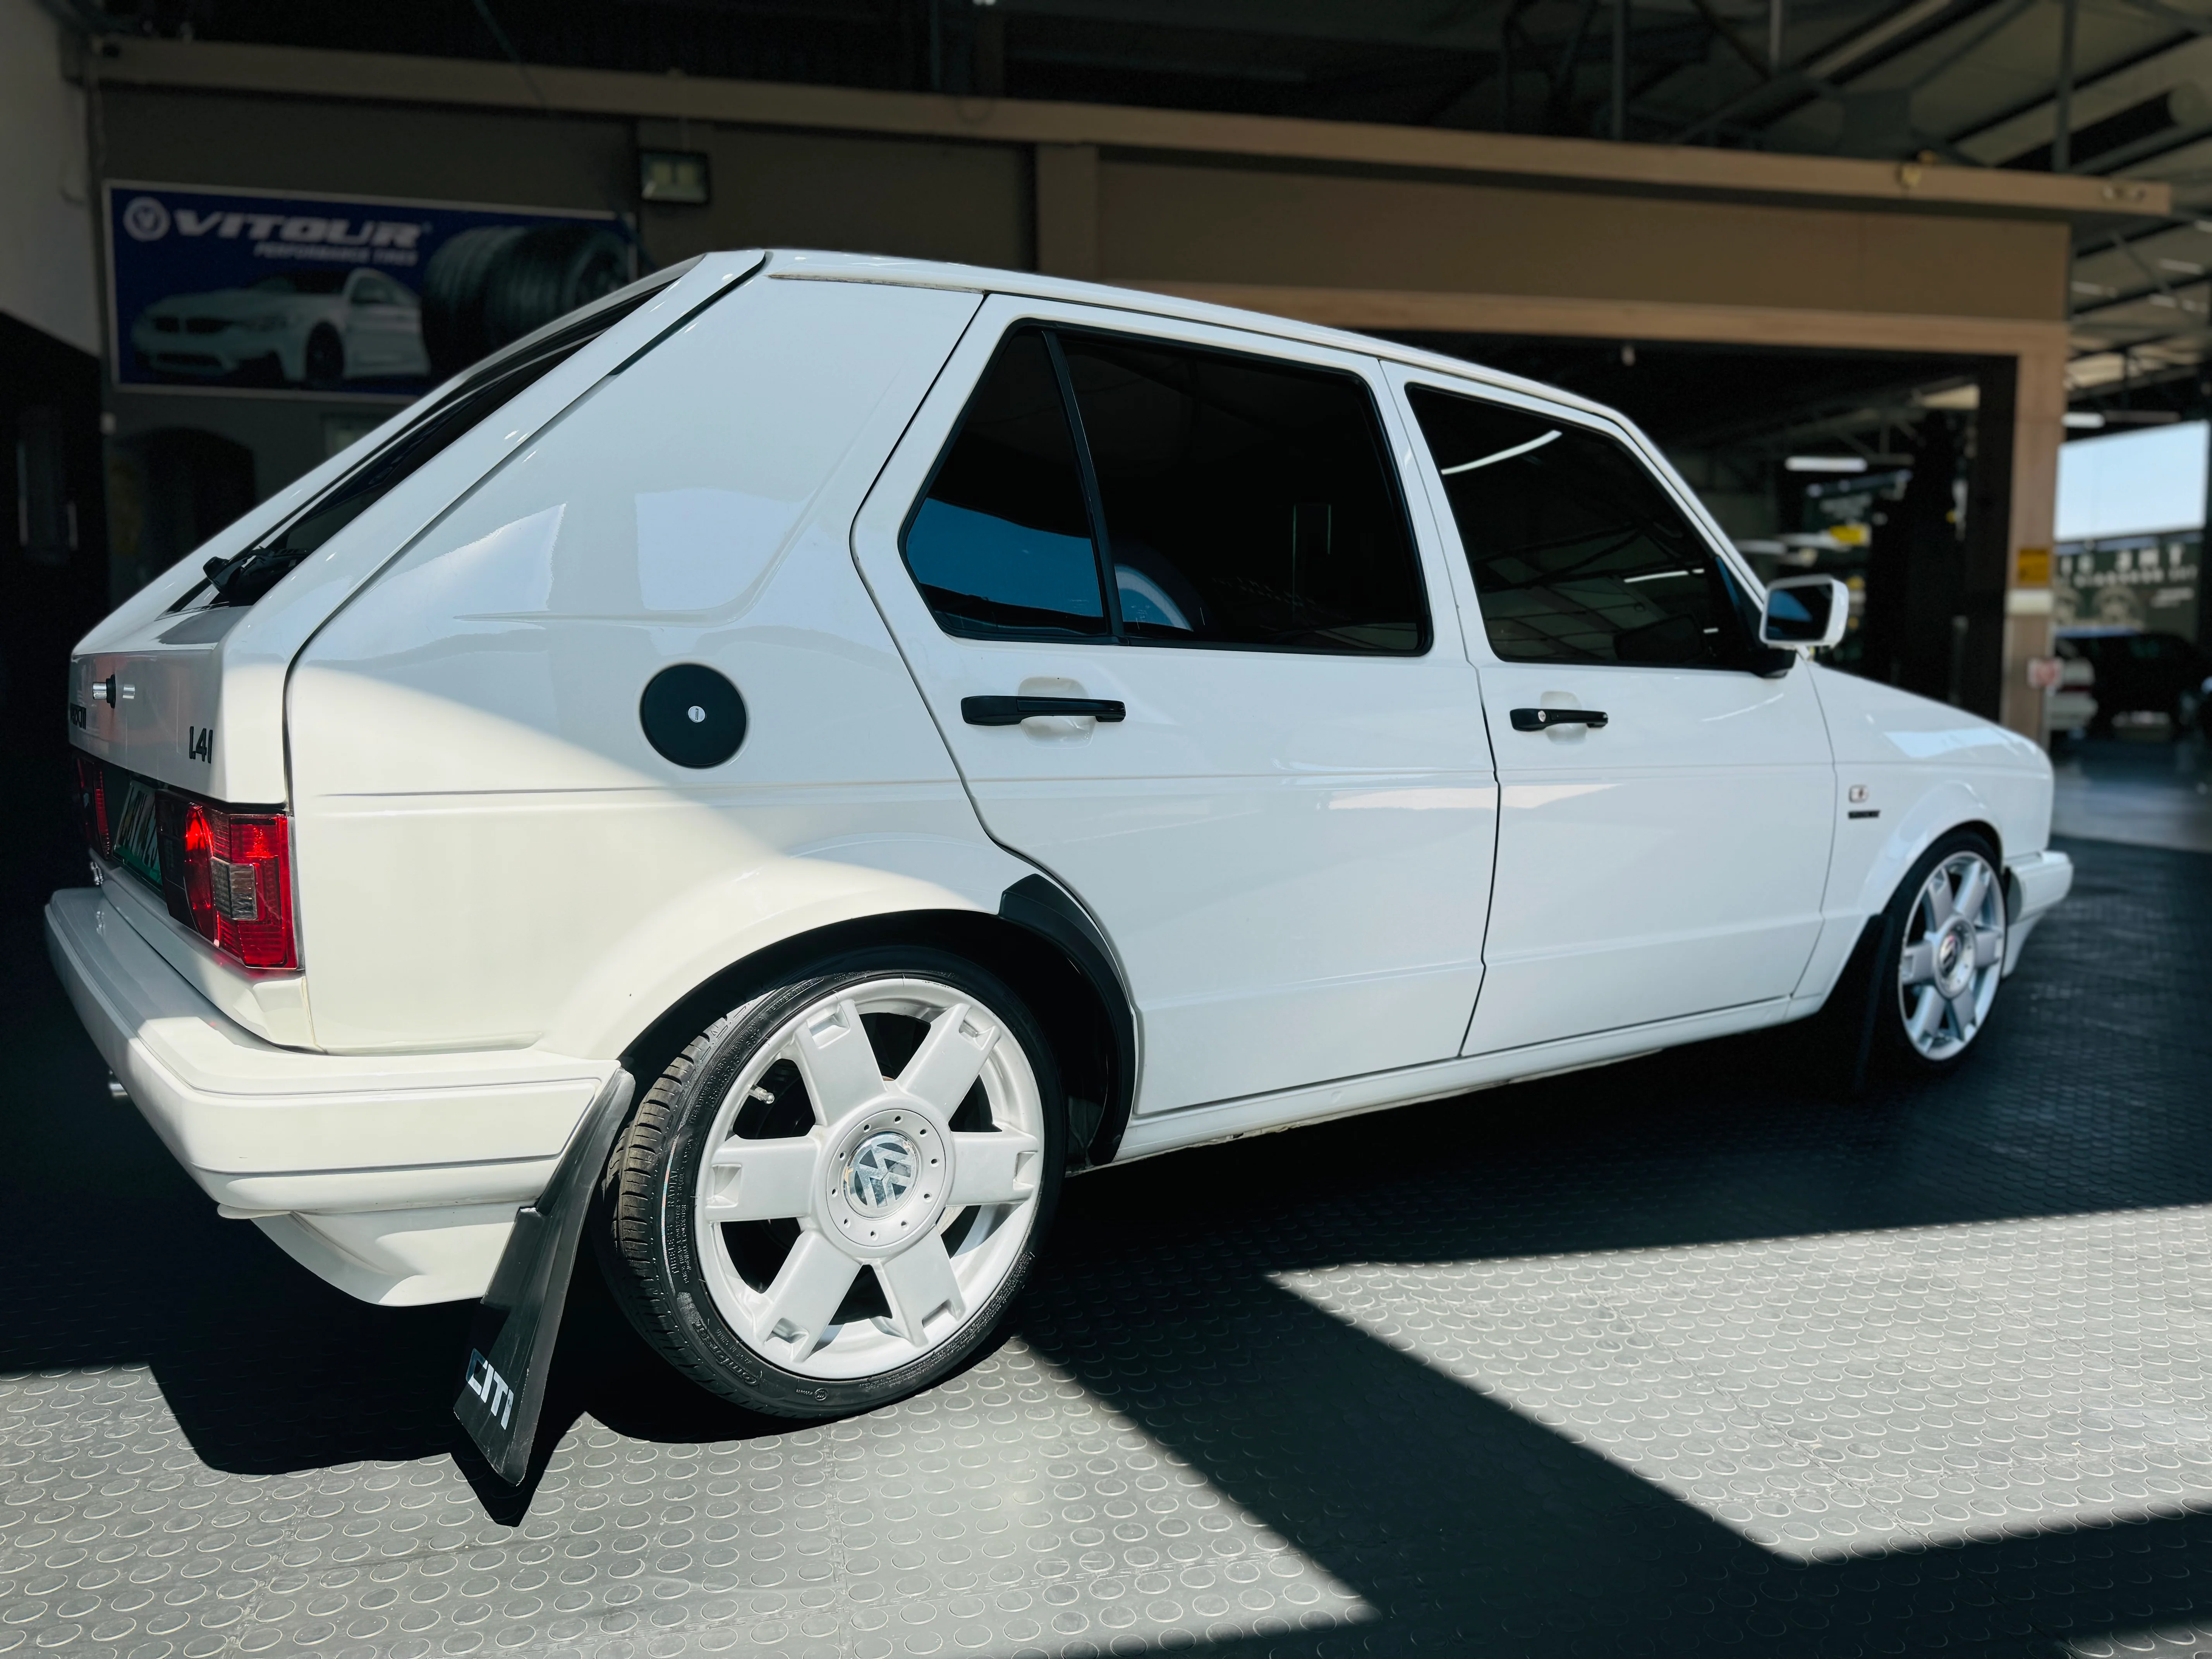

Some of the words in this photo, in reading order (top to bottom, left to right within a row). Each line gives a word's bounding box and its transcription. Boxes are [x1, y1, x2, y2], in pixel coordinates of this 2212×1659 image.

[173, 208, 422, 249] VITOUR
[729, 1022, 757, 1055] TRACTION
[766, 981, 813, 1015] TEMPERATURE
[668, 1168, 679, 1207] RADIAL
[667, 1224, 679, 1274] TUBELESS
